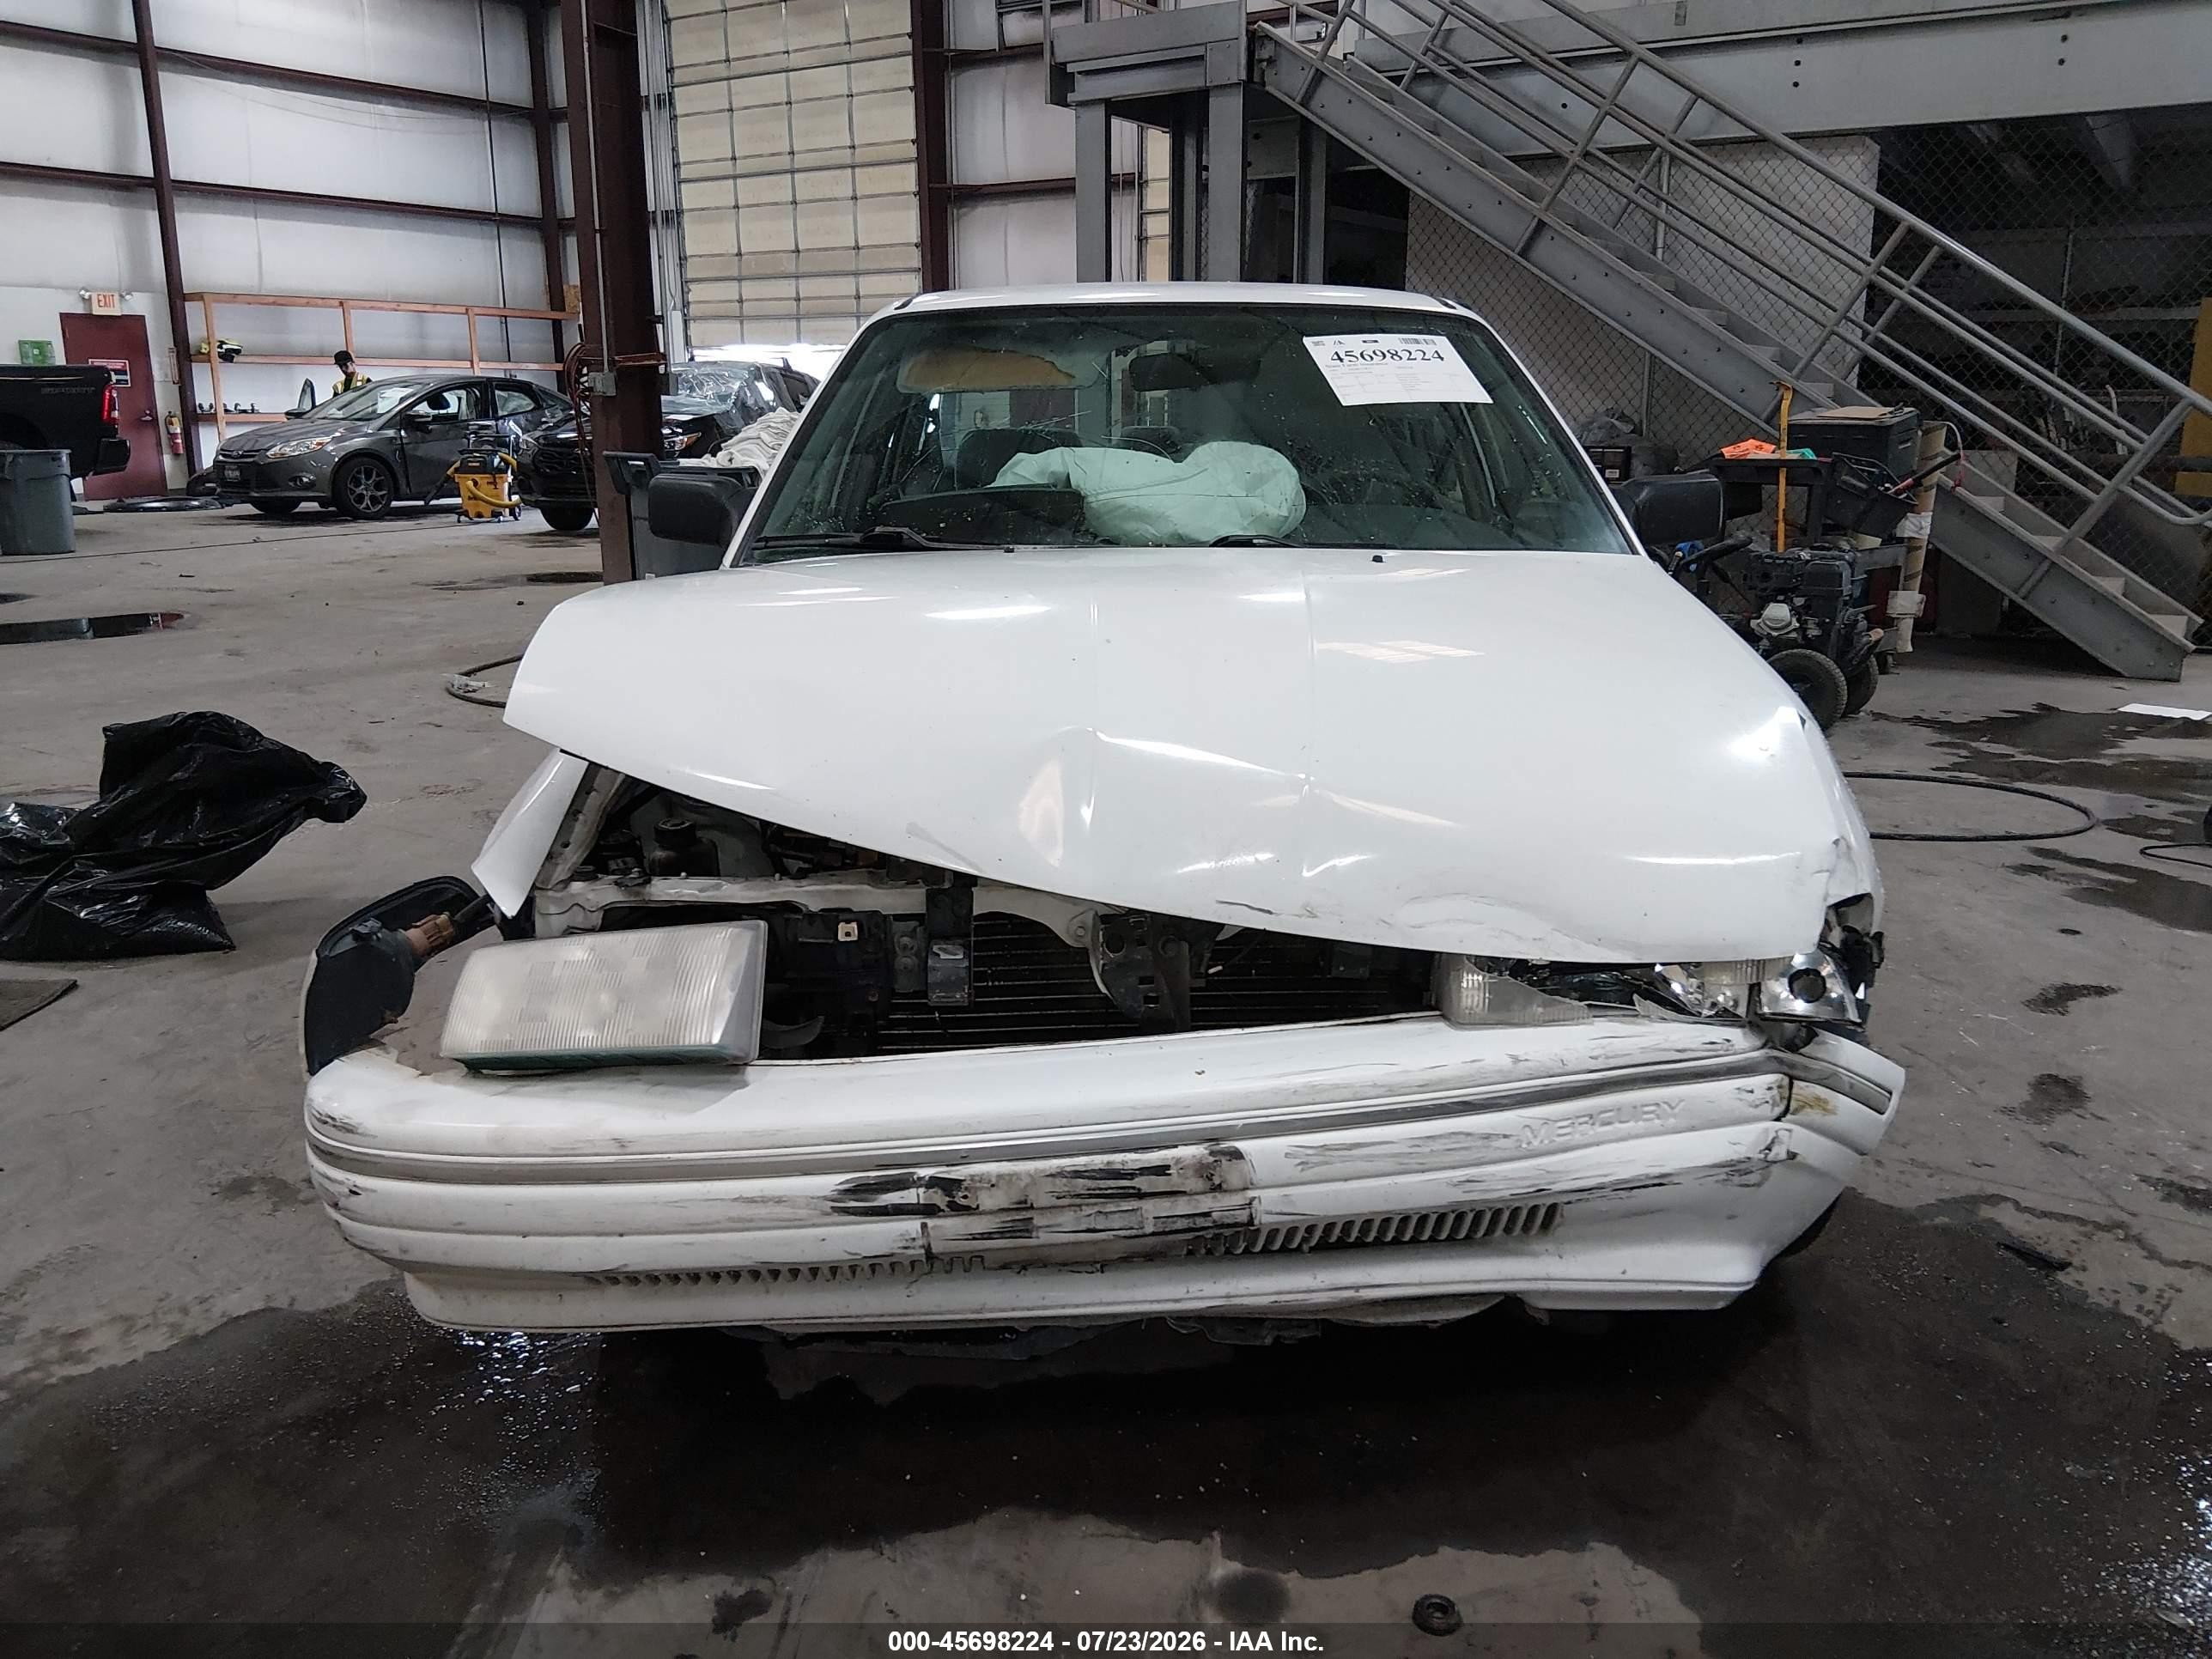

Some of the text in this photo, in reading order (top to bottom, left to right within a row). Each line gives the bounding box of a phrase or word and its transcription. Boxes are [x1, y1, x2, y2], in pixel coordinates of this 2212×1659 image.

[97, 293, 116, 308] EXIT
[1331, 349, 1444, 363] 45698224
[1520, 1098, 1685, 1147] MERCURY
